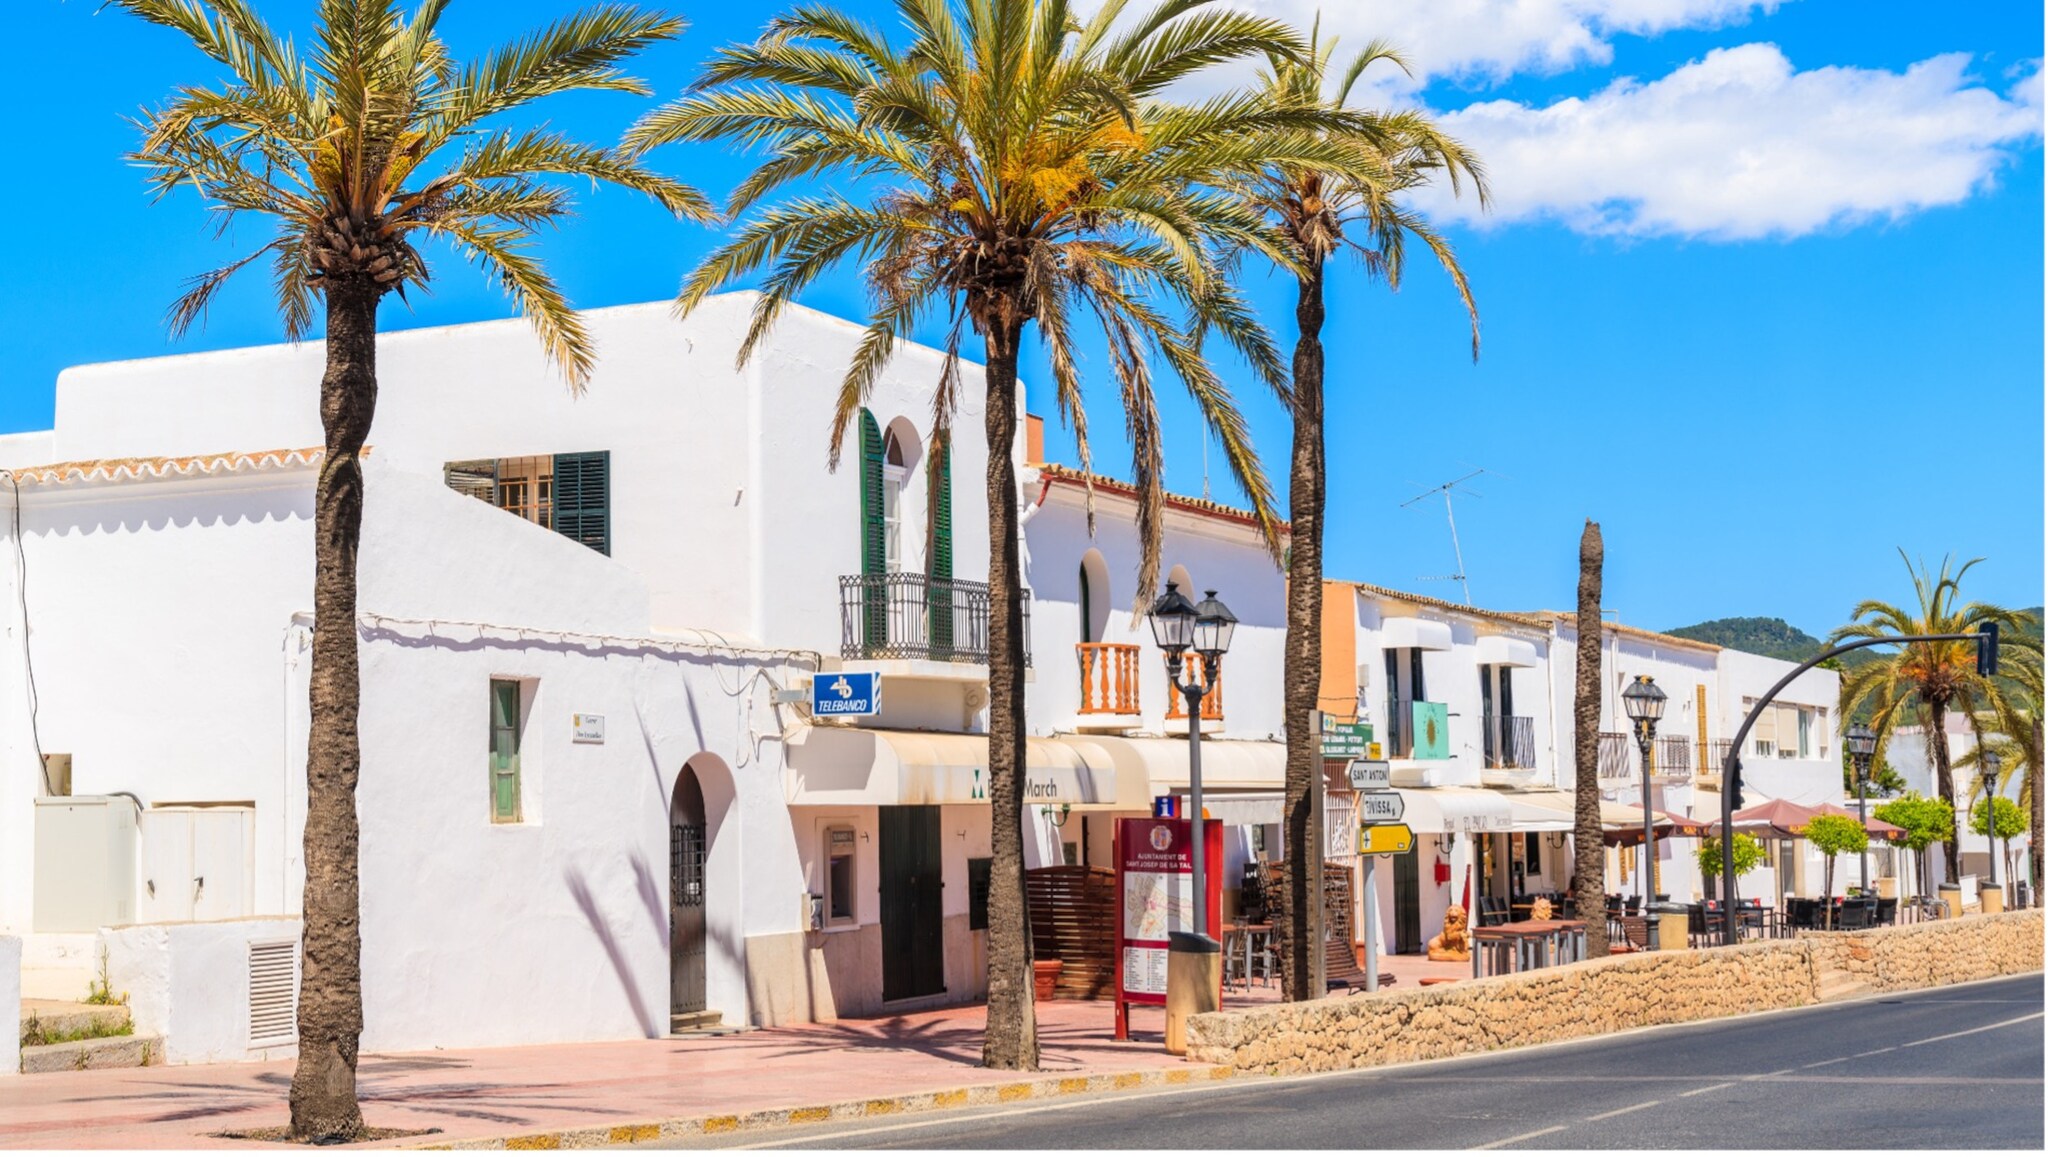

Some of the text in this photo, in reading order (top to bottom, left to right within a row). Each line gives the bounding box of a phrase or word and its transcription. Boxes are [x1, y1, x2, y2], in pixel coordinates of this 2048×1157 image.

[818, 699, 868, 712] TELEBANCO
[1353, 769, 1367, 780] SANT
[1024, 778, 1057, 797] March
[1159, 861, 1168, 869] DE
